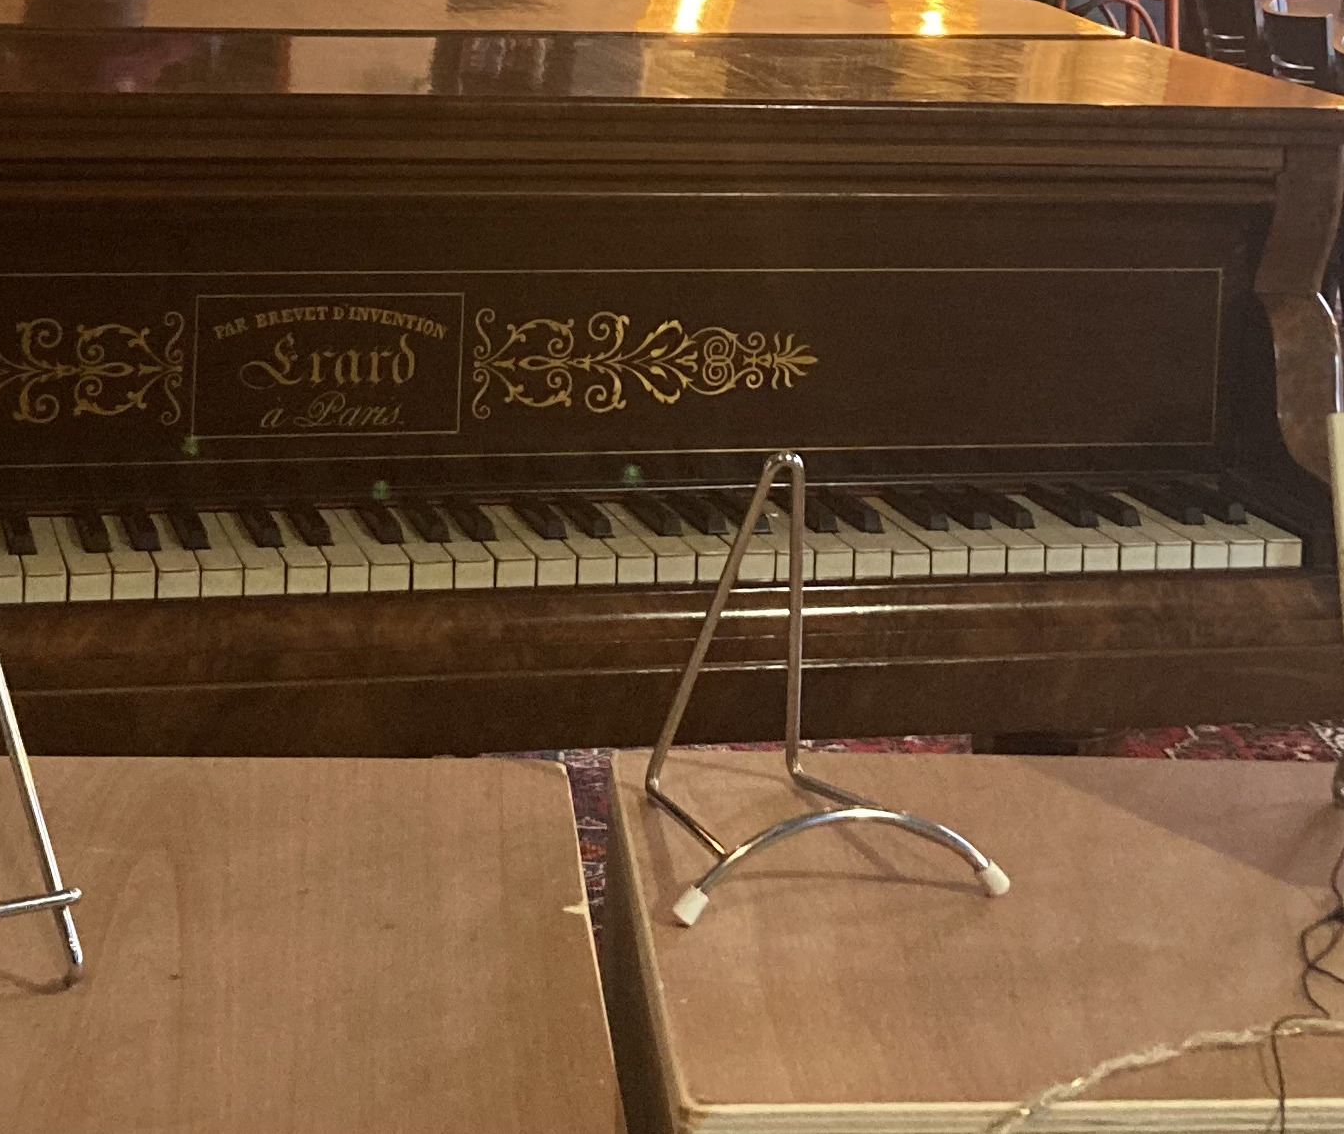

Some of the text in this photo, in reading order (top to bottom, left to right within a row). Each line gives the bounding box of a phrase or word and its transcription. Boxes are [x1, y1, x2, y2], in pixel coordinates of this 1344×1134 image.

[212, 305, 450, 341] PAR BREVET D'INVENTION
